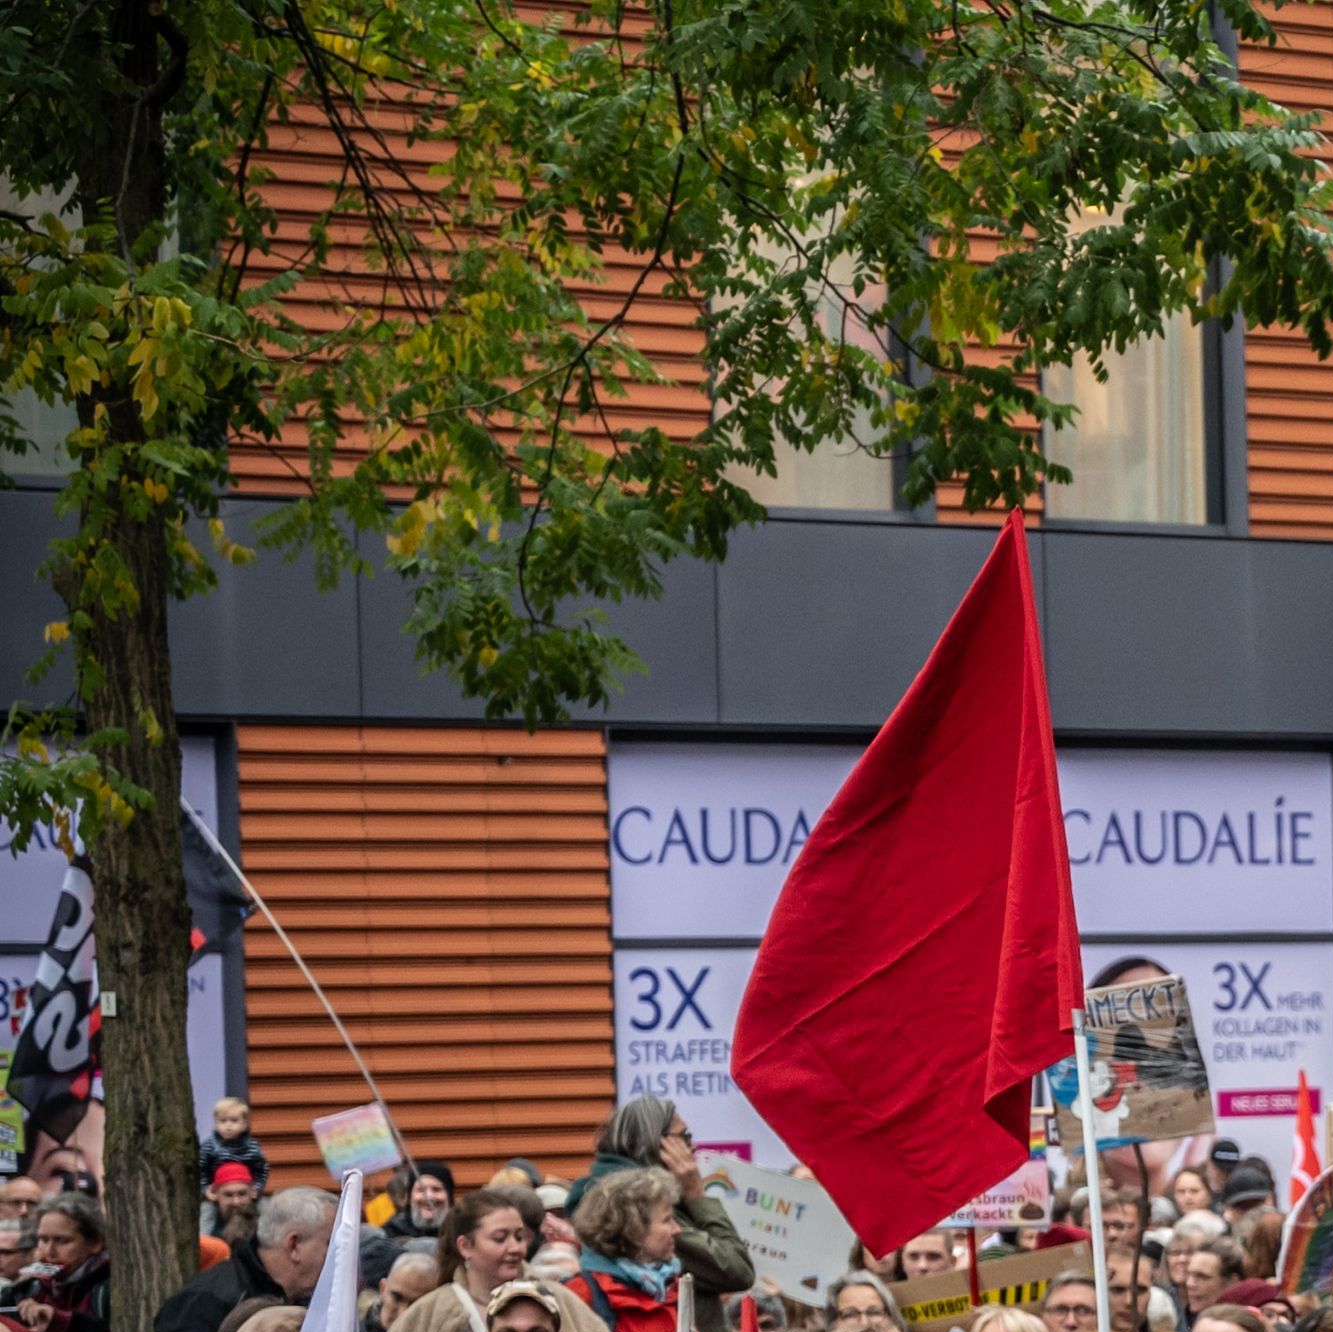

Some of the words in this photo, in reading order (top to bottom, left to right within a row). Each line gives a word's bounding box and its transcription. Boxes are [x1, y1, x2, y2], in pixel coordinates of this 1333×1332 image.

[1064, 796, 1316, 866] CAUDALÍE
[628, 965, 711, 1031] 3X
[1212, 961, 1273, 1011] 3X
[1212, 1016, 1298, 1037] KOLLAGEN
[1302, 1017, 1321, 1034] IN
[1212, 1041, 1246, 1062] DER
[630, 1071, 668, 1096] ALS
[744, 1186, 808, 1222] BUNT
